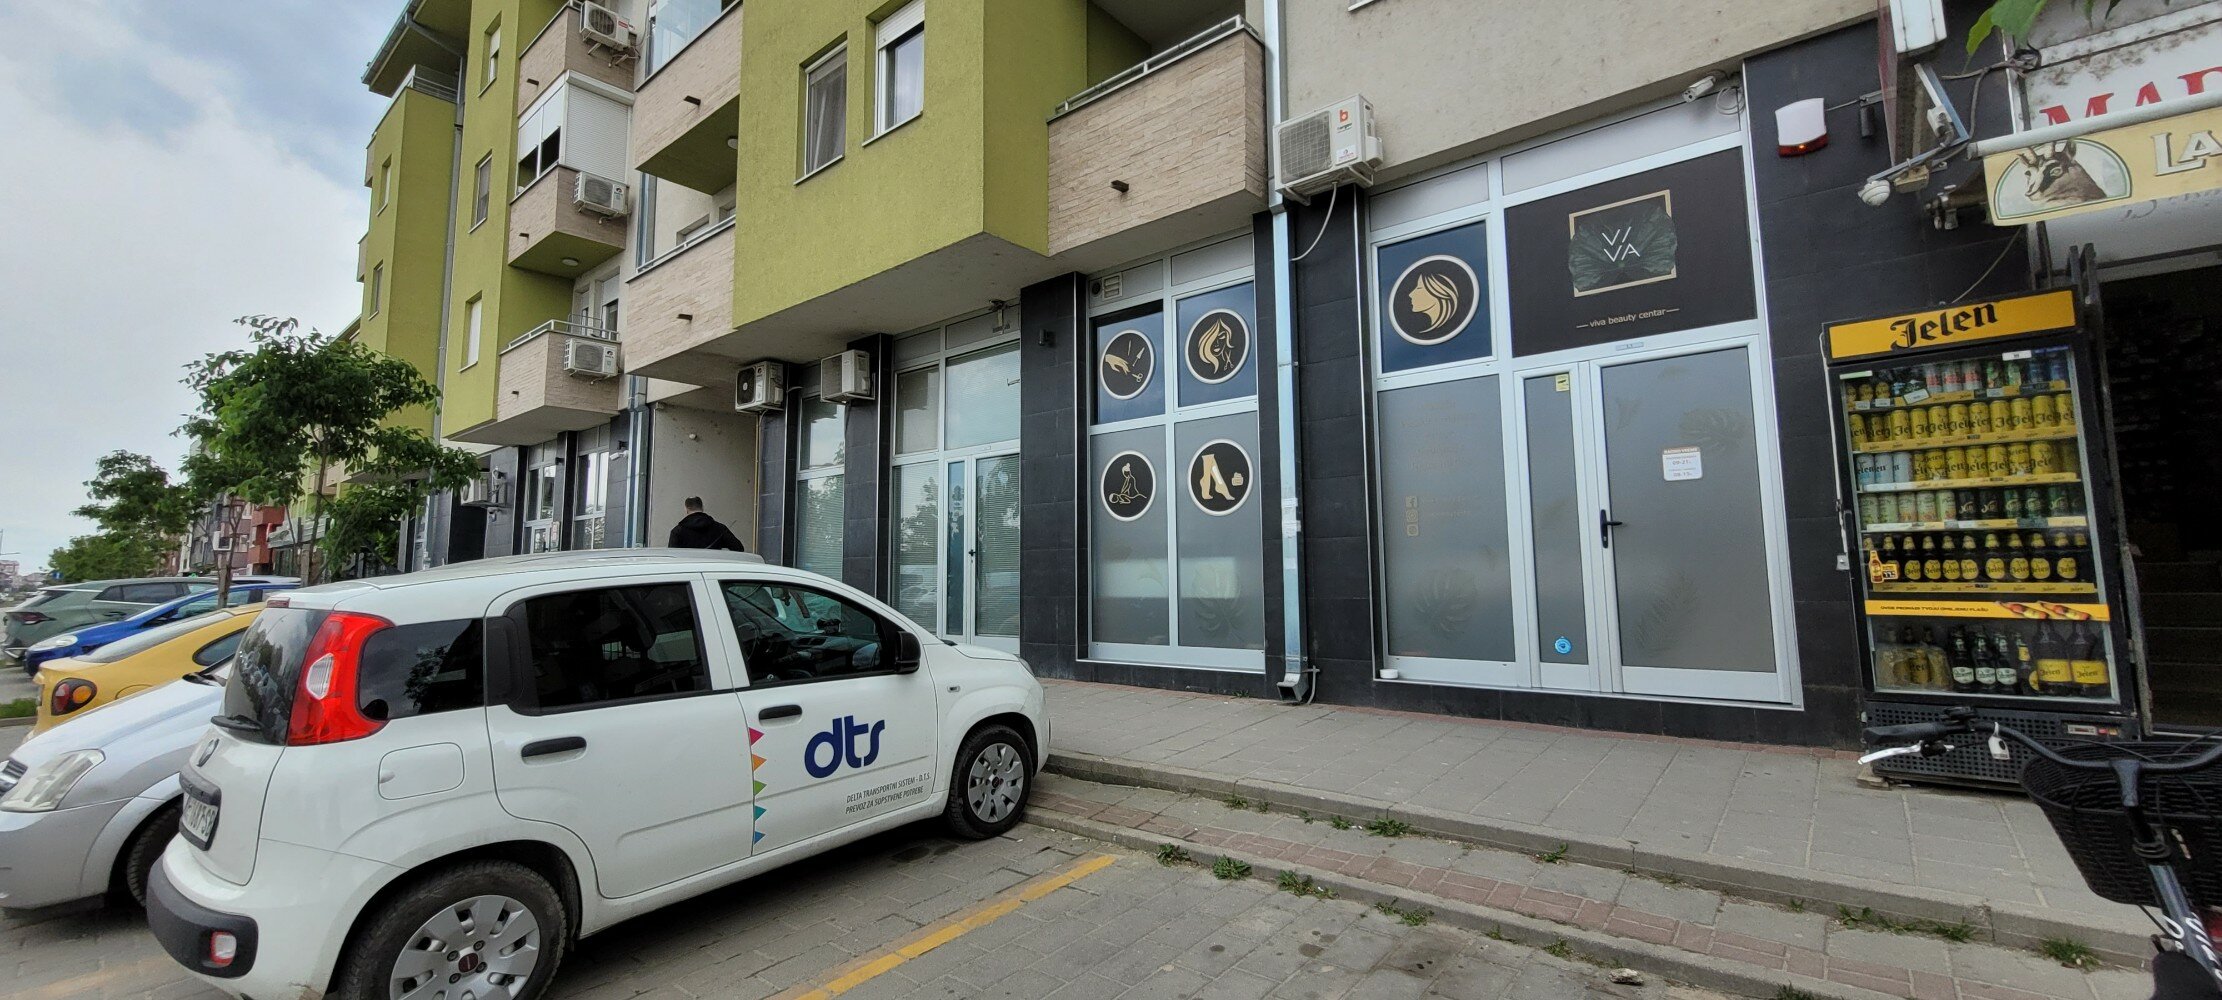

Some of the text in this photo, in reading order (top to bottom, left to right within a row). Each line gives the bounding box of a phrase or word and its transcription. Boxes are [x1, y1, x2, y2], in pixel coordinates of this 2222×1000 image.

[1589, 308, 1666, 328] viva beauty centar
[1890, 304, 1998, 348] Jelen
[804, 714, 886, 779] dts
[845, 785, 924, 814] PREVOZ ZA SOPSTVENE POTREBE
[846, 792, 863, 803] DELTA
[862, 782, 898, 799] TRANSPORTNI
[897, 777, 915, 788] SISTEM
